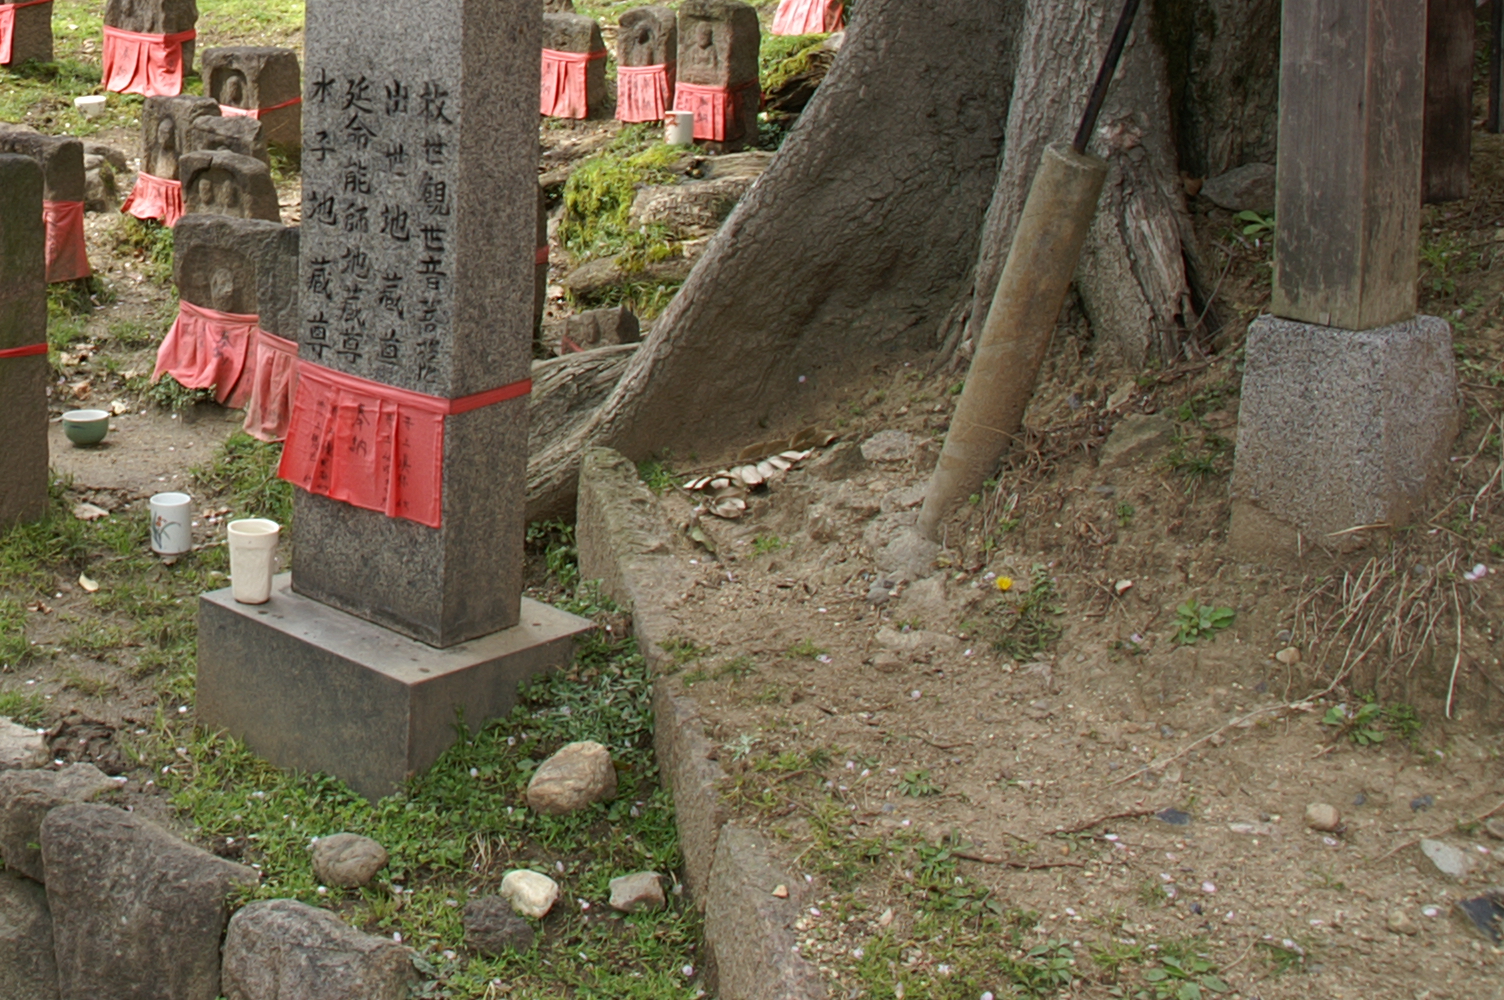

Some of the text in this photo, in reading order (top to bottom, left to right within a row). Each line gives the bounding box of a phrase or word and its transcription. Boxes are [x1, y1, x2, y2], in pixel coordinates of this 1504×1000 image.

[305, 68, 336, 359] 水子地蔵尊
[349, 402, 371, 458] 奉納
